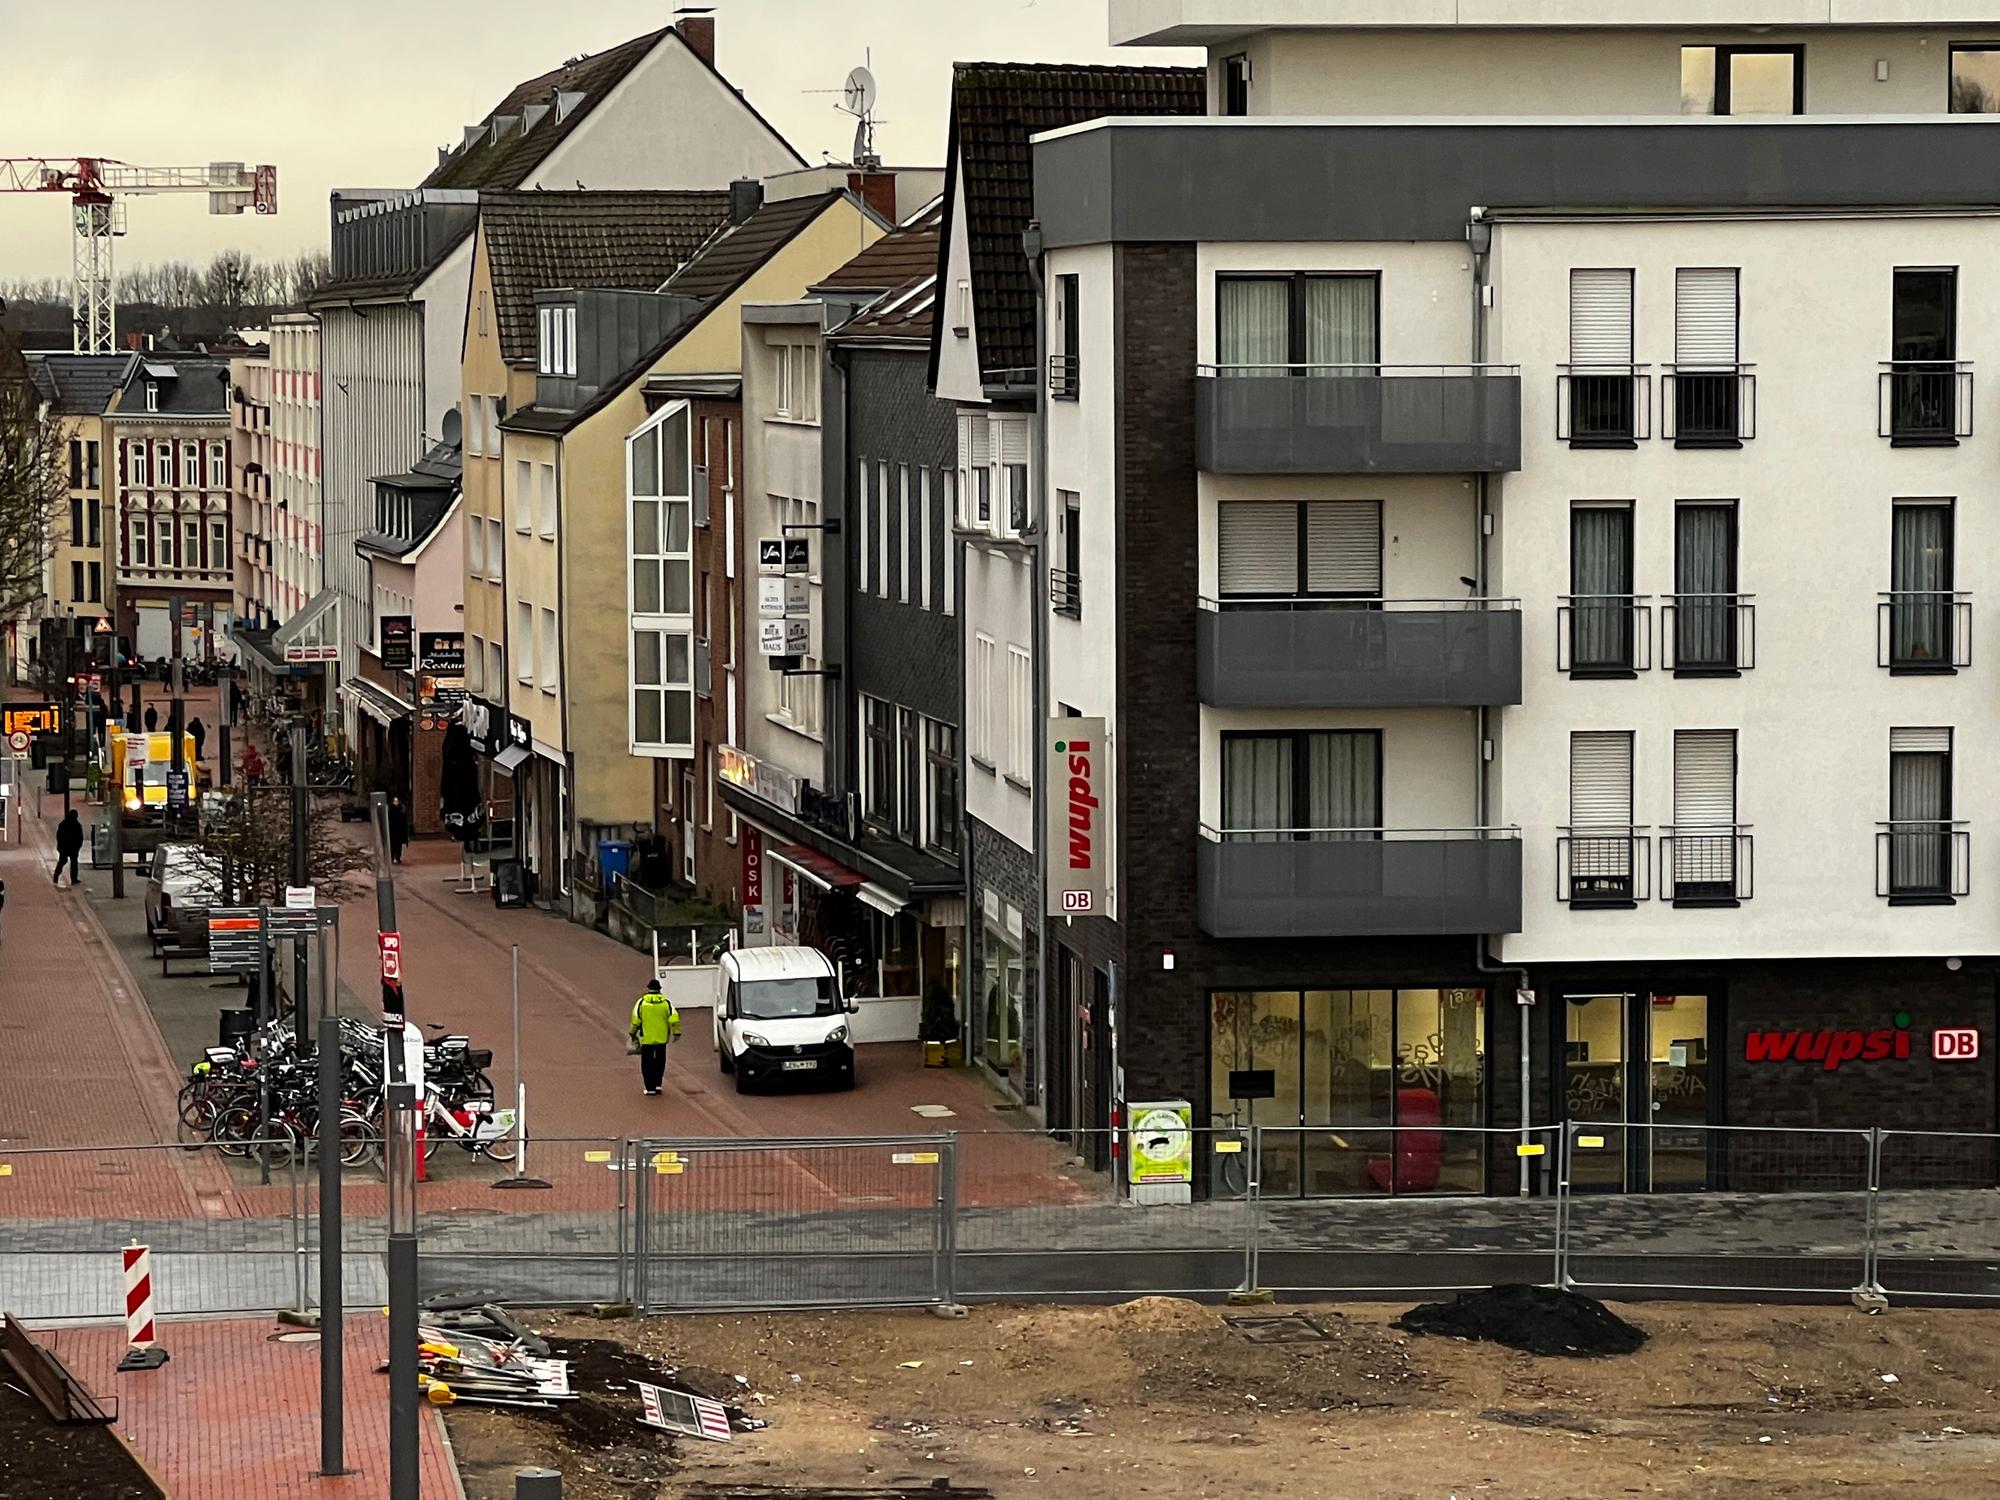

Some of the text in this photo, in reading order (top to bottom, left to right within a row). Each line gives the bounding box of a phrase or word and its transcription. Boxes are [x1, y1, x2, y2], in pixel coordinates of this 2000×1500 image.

[1054, 740, 1100, 870] wupsi
[747, 825, 759, 897] KIOSK
[1064, 892, 1089, 909] DB
[1745, 1010, 1975, 1071] wupsi DB
